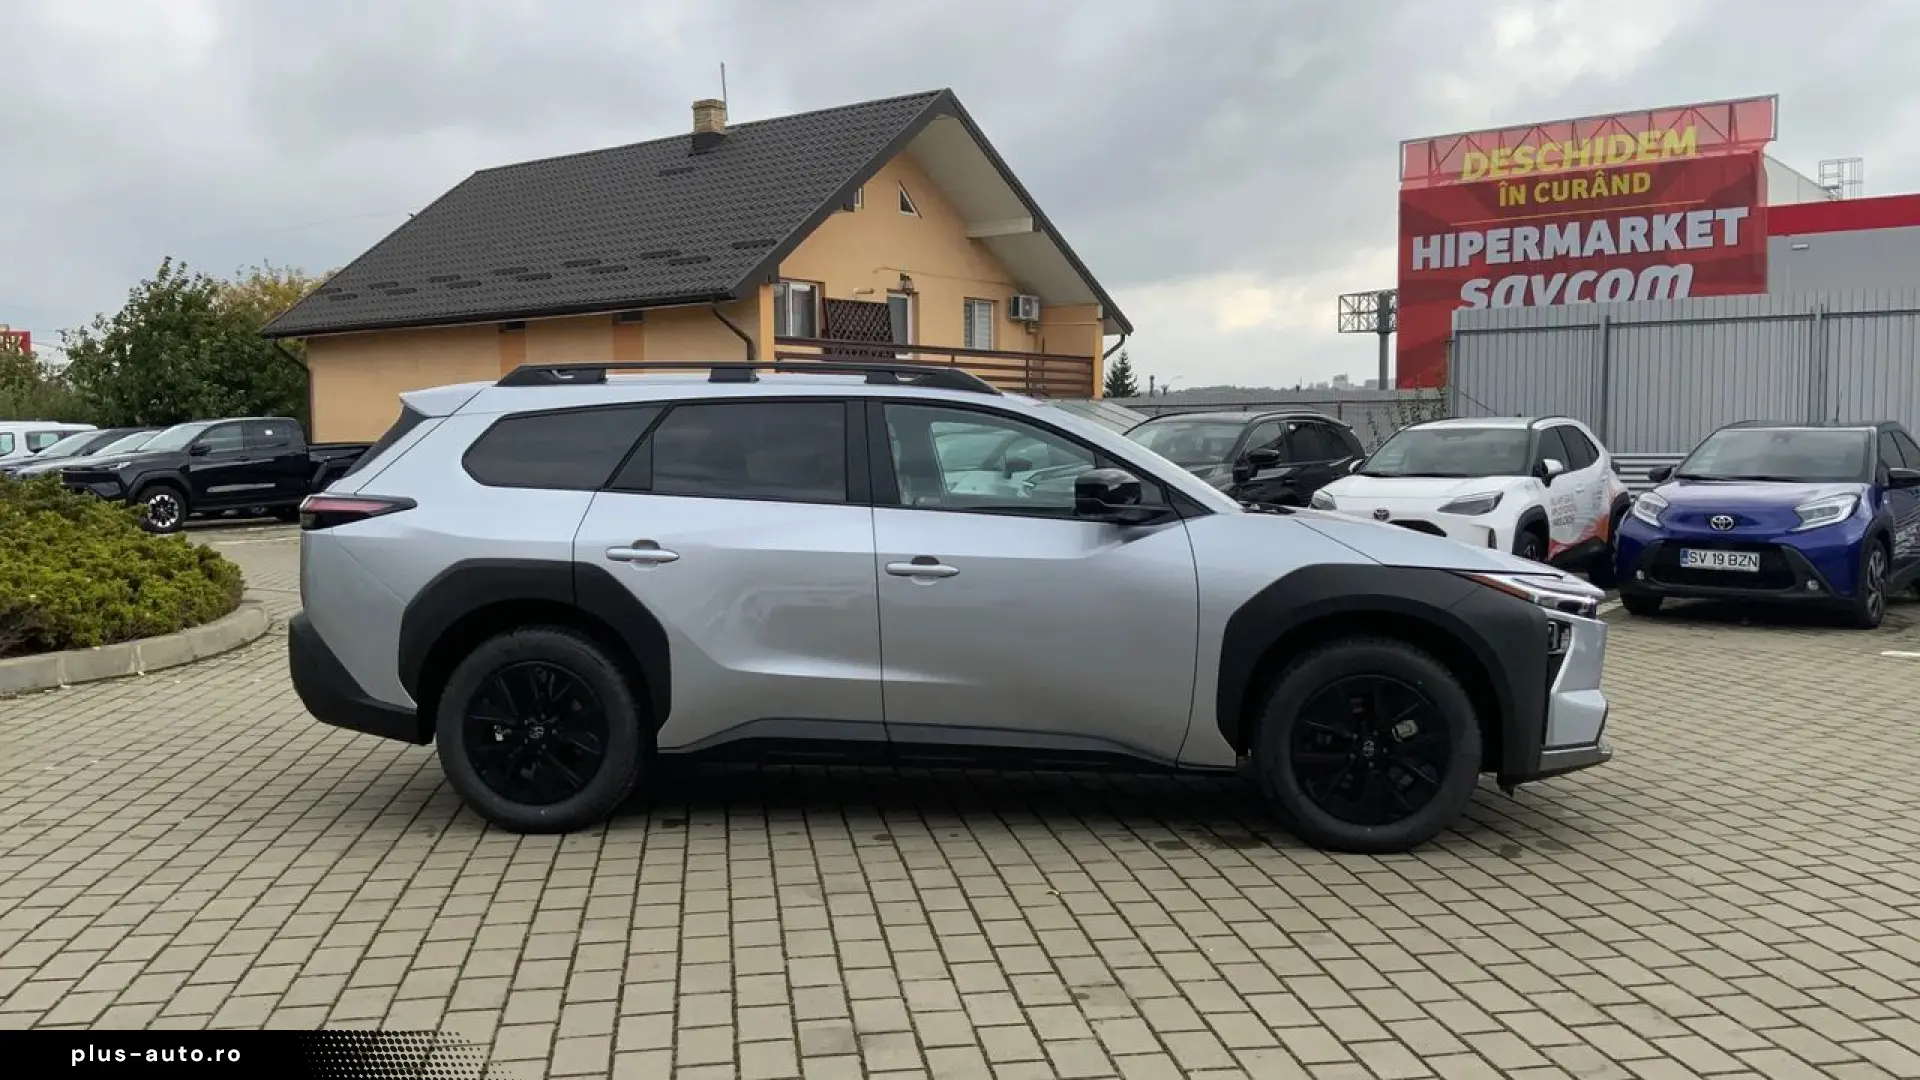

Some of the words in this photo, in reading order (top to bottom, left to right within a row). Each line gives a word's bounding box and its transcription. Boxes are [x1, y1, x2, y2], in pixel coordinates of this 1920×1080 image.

[1462, 126, 1698, 181] DESCHIDEM
[1499, 182, 1526, 207] ÎN
[1534, 171, 1651, 203] CURÂND
[1412, 207, 1750, 271] HIPERMARKET
[1690, 551, 1707, 564] SV
[1712, 553, 1725, 565] 19
[1728, 554, 1758, 567] BZN
